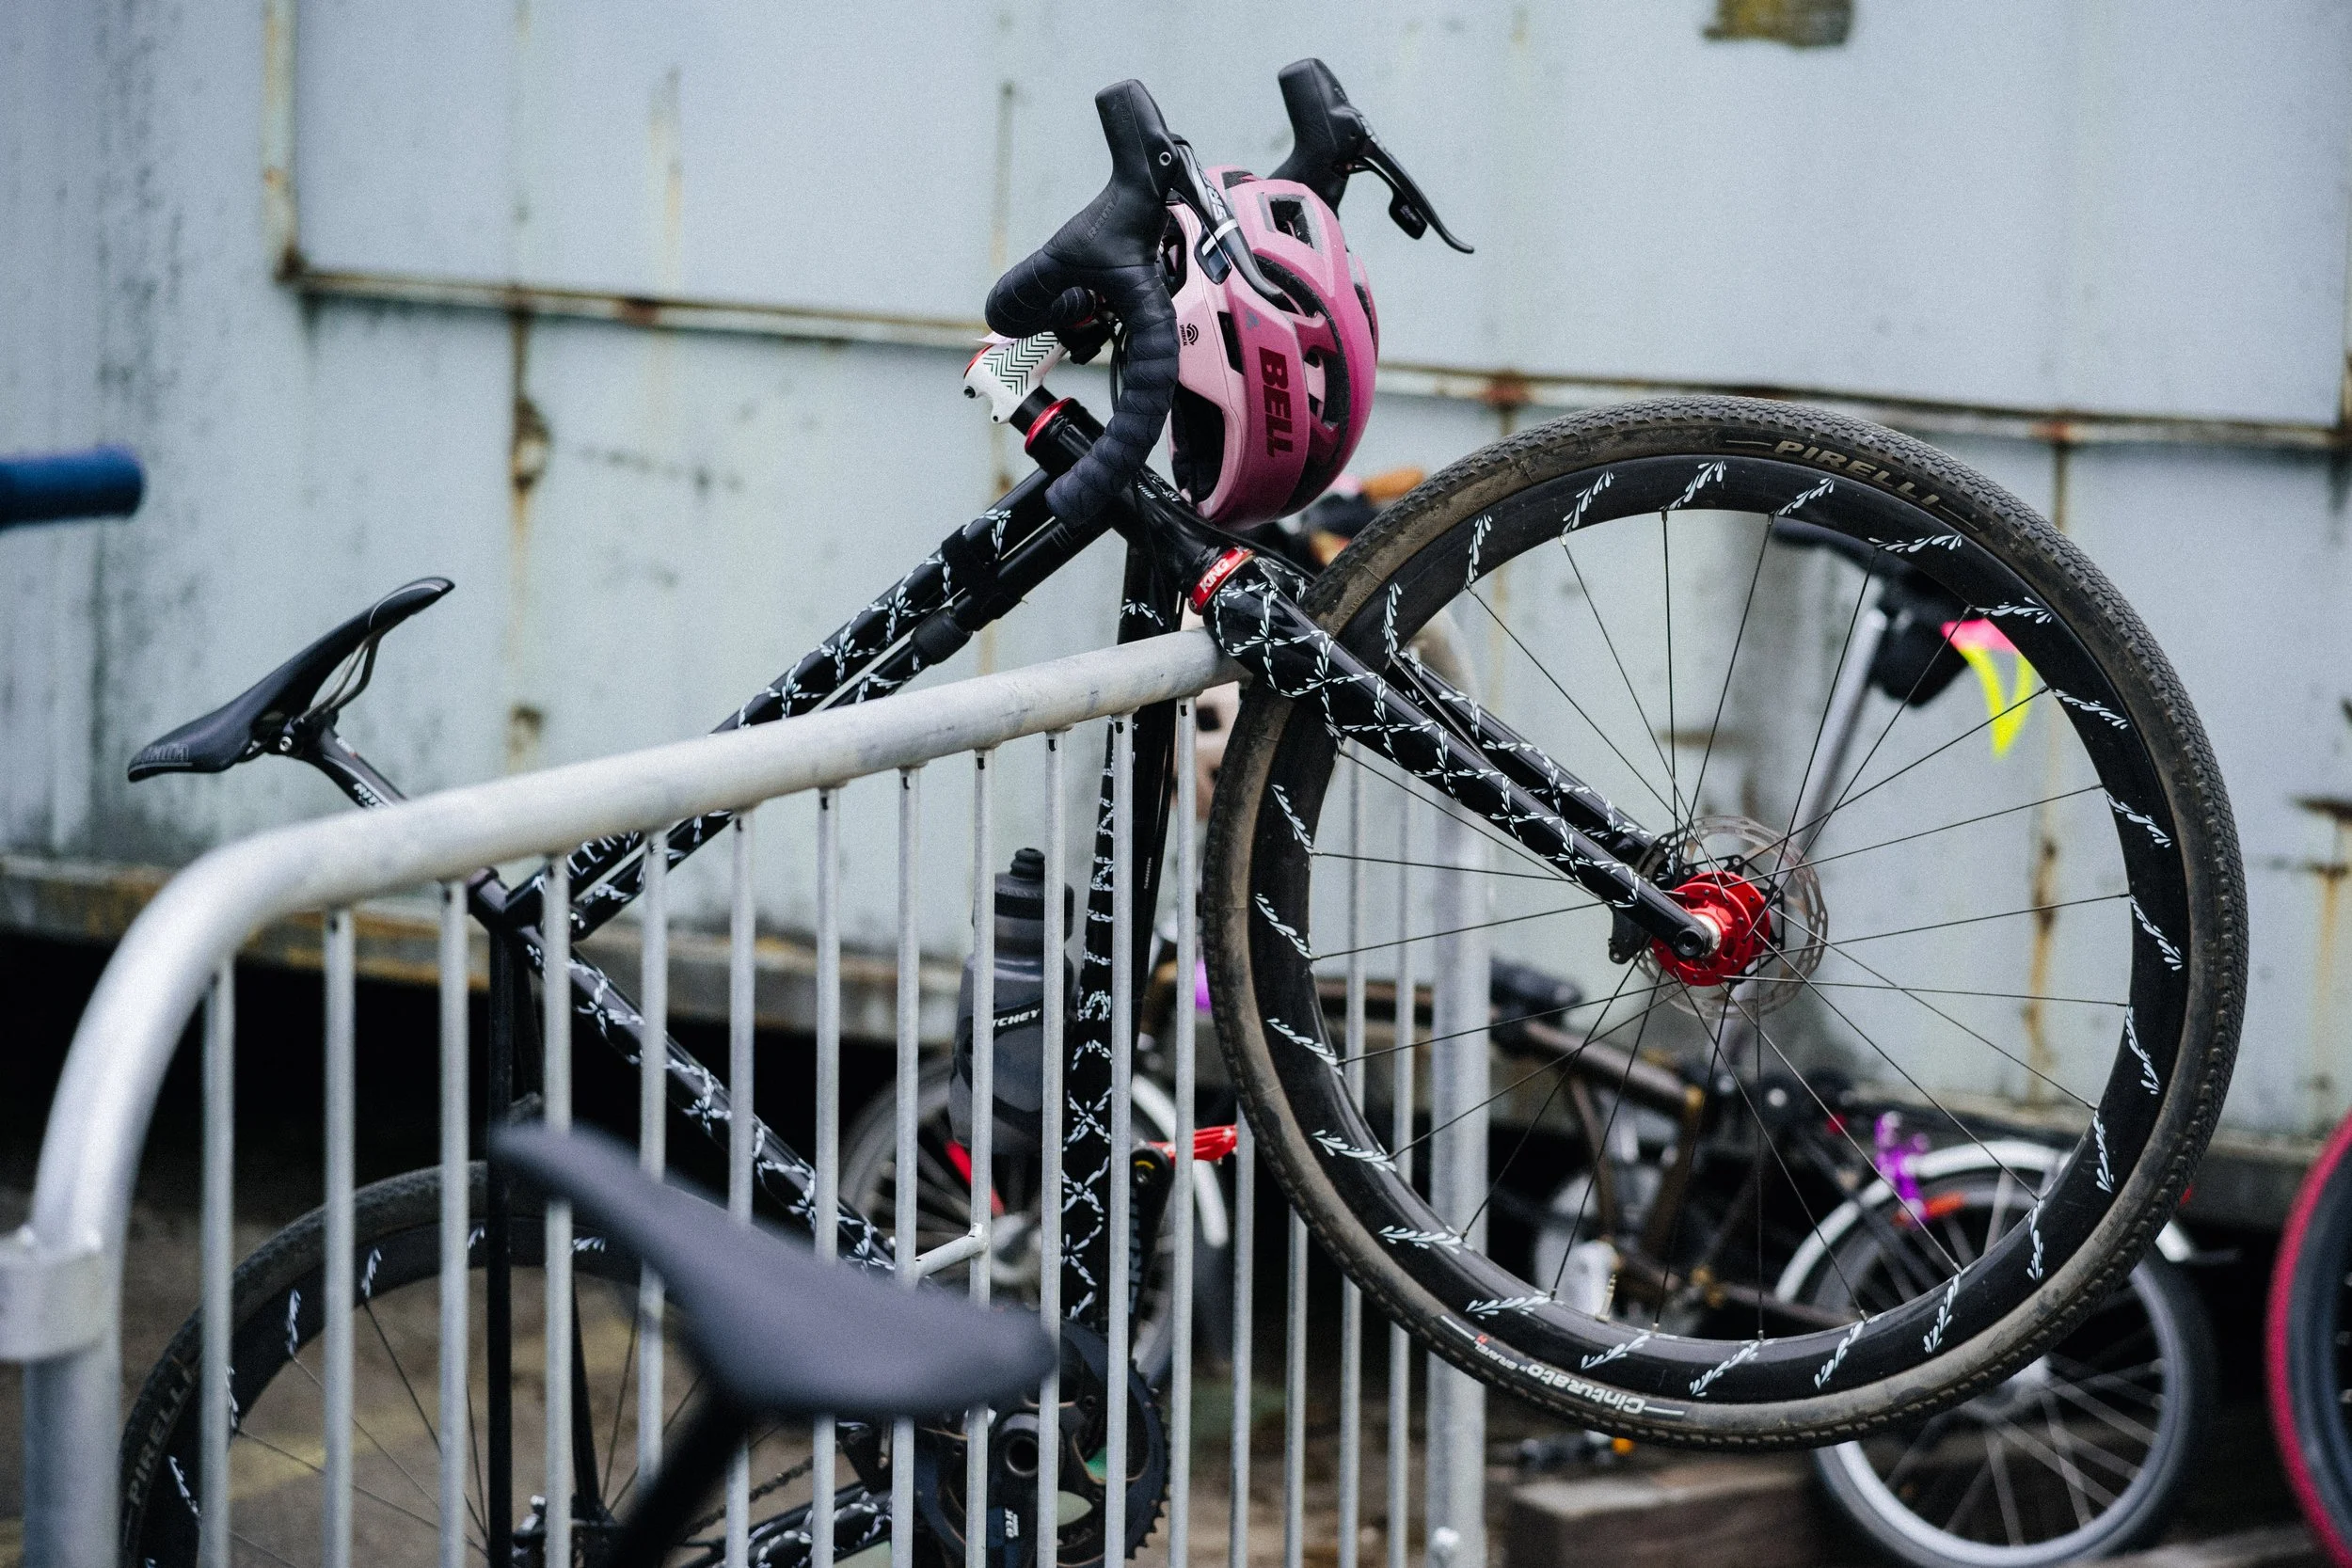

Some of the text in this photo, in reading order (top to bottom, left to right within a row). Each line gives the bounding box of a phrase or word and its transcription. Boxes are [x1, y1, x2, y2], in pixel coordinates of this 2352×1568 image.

[1259, 346, 1294, 457] BELL
[1774, 440, 1940, 506] PIRELLI
[1199, 558, 1231, 594] KING
[1474, 1340, 1518, 1370] GRAVEL
[128, 1369, 193, 1505] PIRELLI
